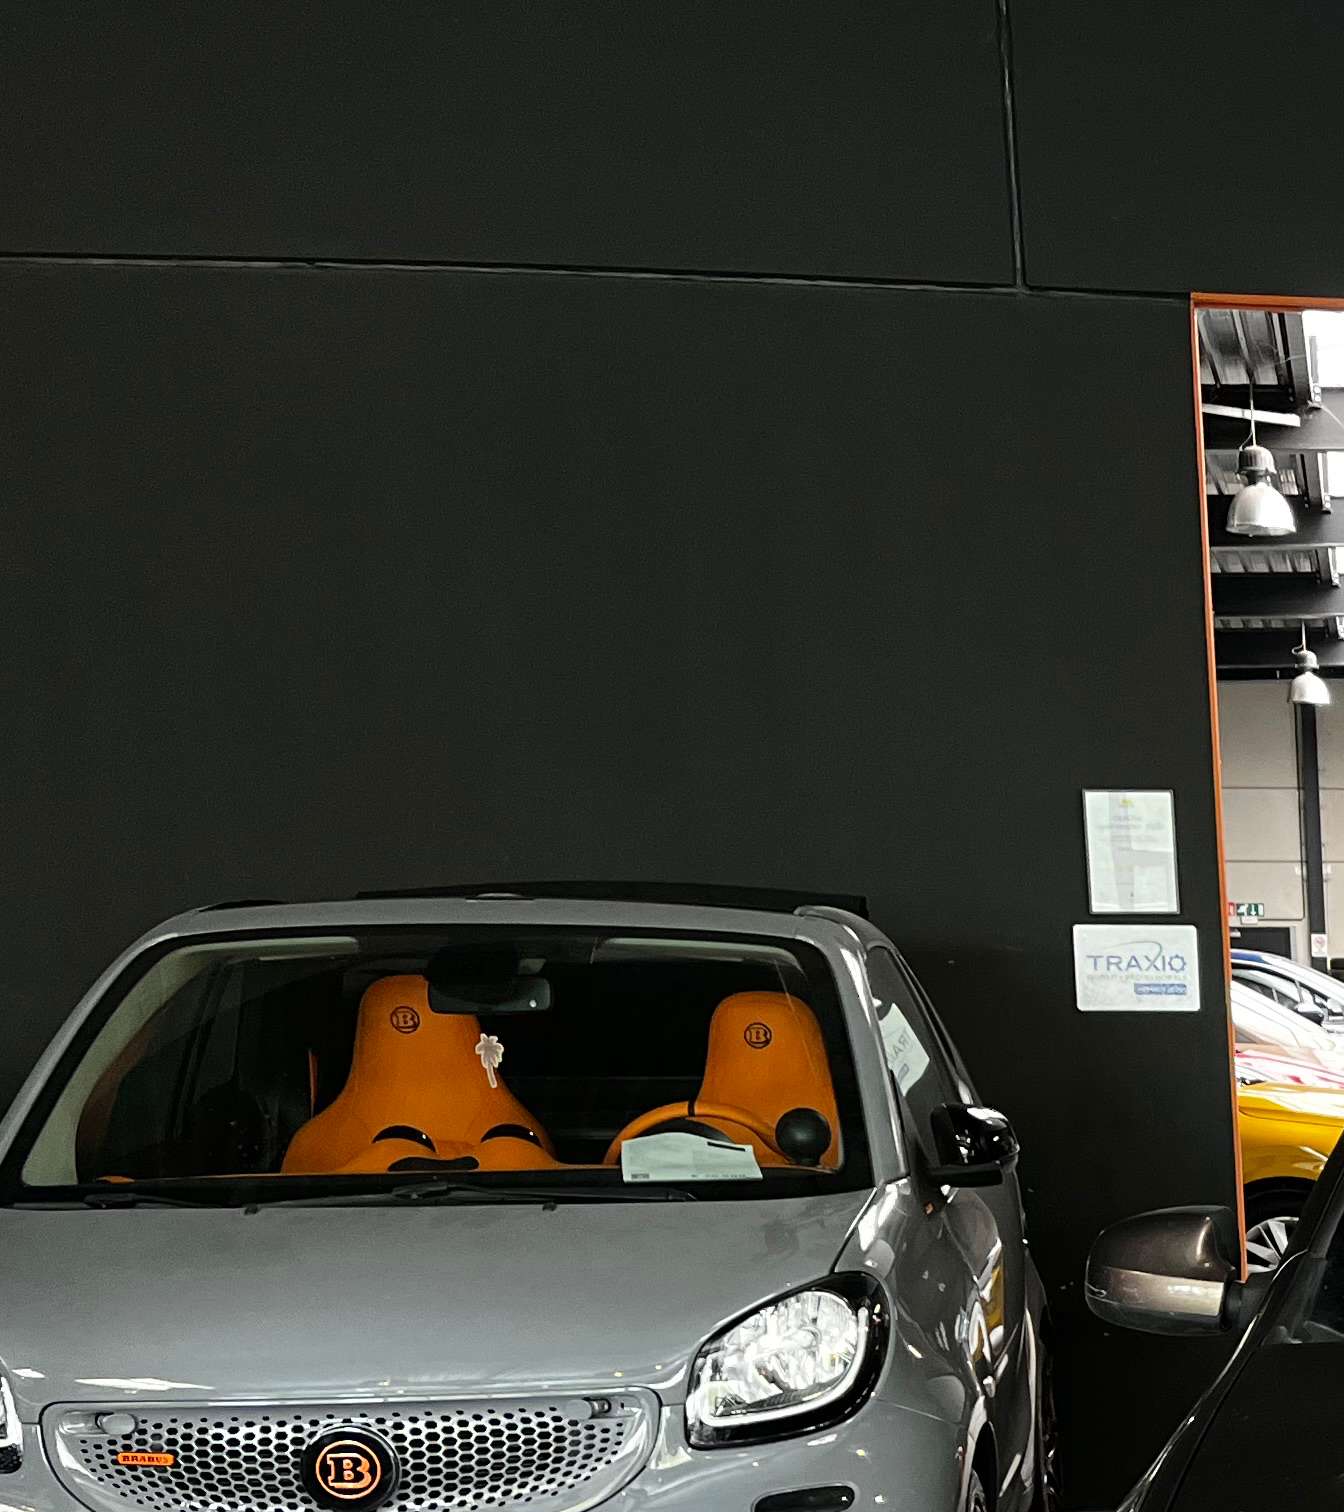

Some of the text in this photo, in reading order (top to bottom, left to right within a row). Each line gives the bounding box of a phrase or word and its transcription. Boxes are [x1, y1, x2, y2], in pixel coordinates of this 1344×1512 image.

[1086, 953, 1187, 973] TRAXIO
[122, 1455, 169, 1463] BRABUS
[326, 1452, 370, 1488] B
